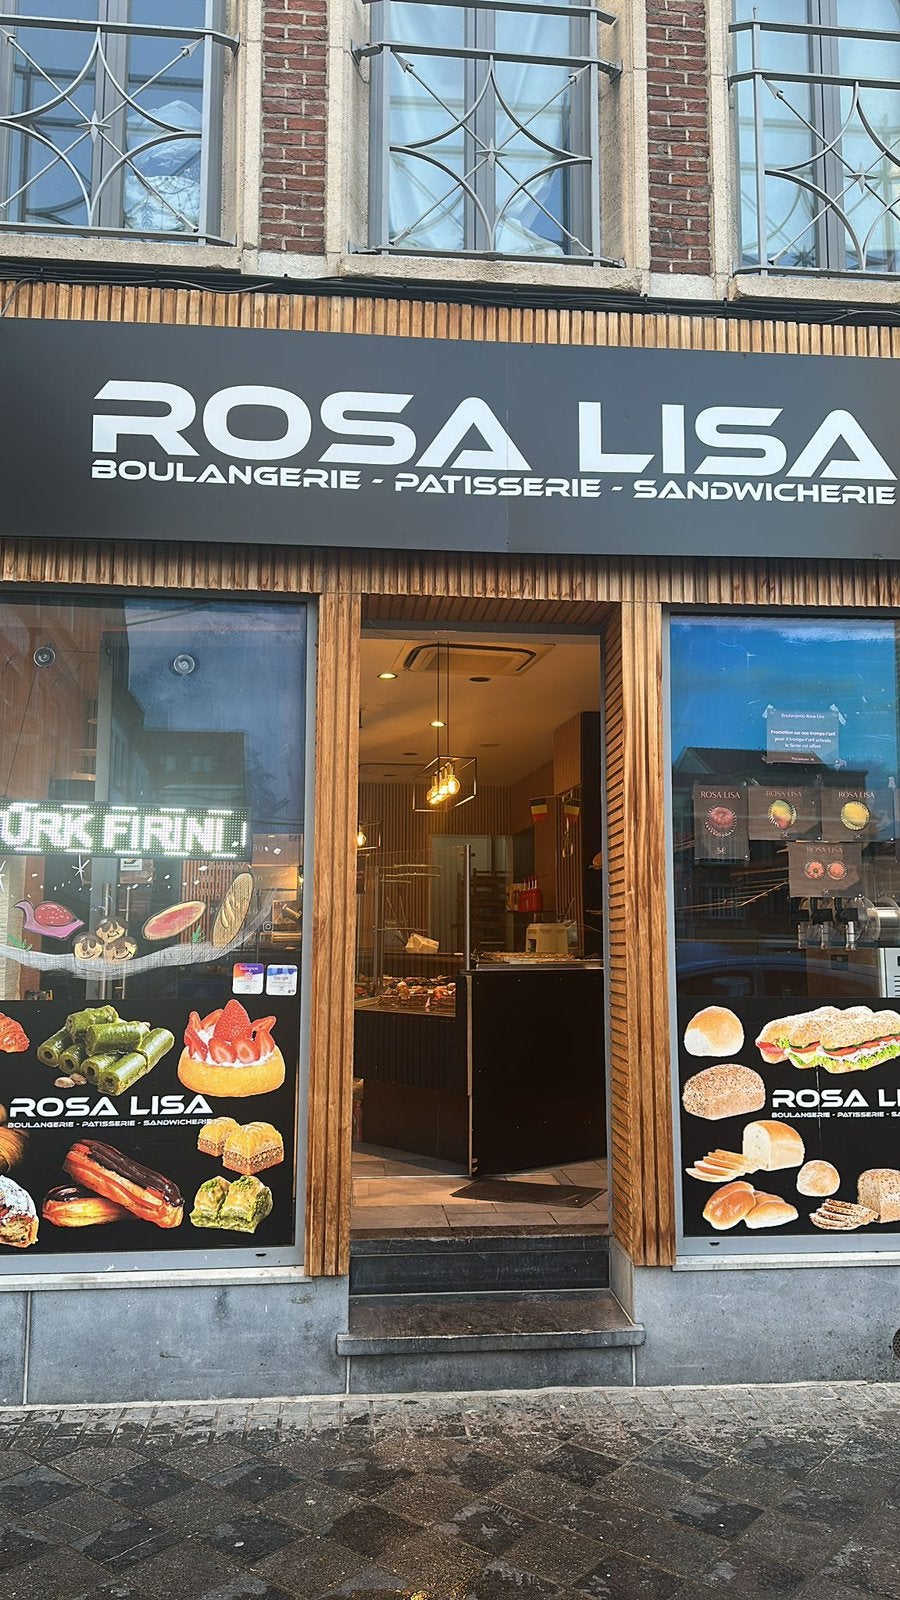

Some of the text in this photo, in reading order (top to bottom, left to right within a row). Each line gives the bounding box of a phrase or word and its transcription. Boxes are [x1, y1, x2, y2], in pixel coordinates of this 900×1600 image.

[92, 380, 898, 480] ROSA LISA
[92, 459, 361, 490] BOULANGERIE
[395, 473, 601, 498] PATISSERIE
[633, 479, 897, 505] SANDWICHERIE
[700, 791, 741, 799] ROSA LISA
[766, 789, 802, 798] ROSA LISA
[859, 791, 875, 799] LISA
[10, 1094, 214, 1118] ROSA LISA
[772, 1089, 869, 1108] ROSA
